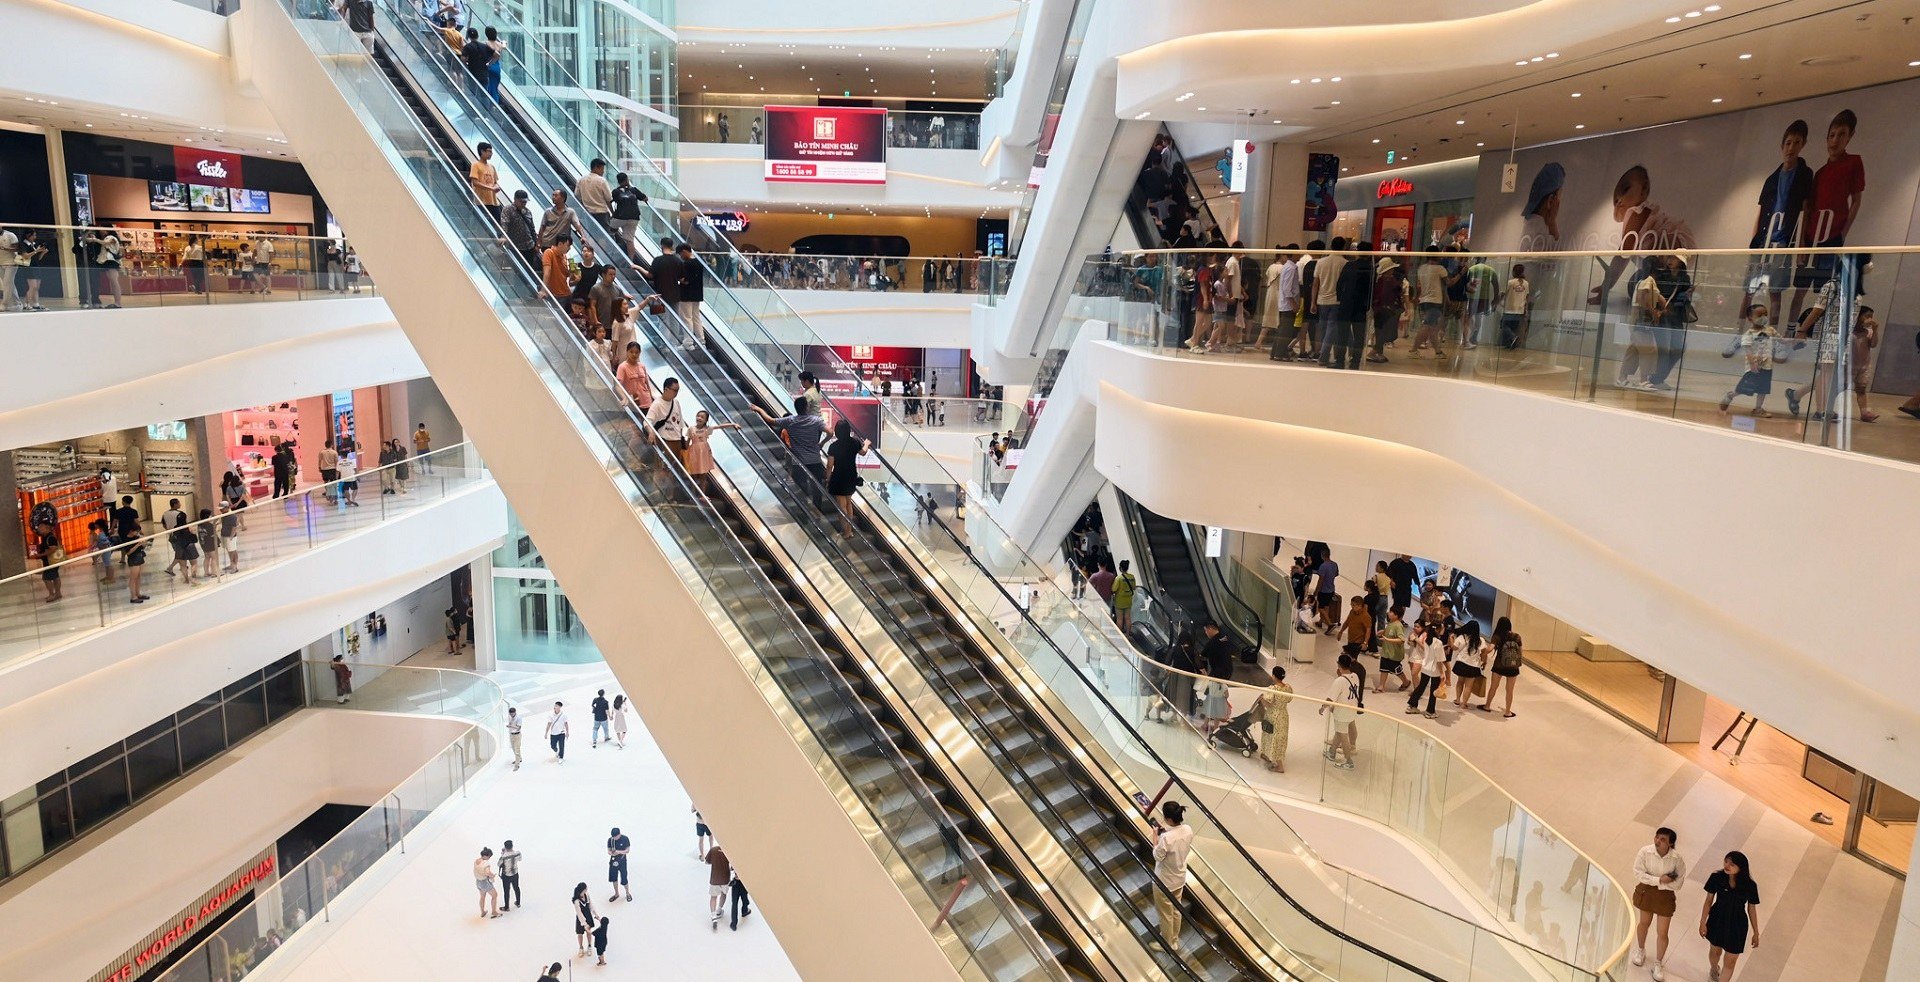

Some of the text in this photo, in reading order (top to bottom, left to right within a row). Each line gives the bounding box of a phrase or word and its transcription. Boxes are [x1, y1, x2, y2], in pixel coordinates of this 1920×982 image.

[794, 141, 808, 149] BẢO
[809, 141, 820, 149] TÍN
[840, 142, 859, 150] CHÂU
[196, 159, 228, 178] Fissler
[1236, 161, 1243, 171] 3
[1605, 229, 1682, 257] SOON
[1760, 209, 1835, 269] GAP
[1212, 528, 1218, 537] 2
[135, 915, 197, 967] WORLD
[199, 855, 275, 921] AQUARIUM
